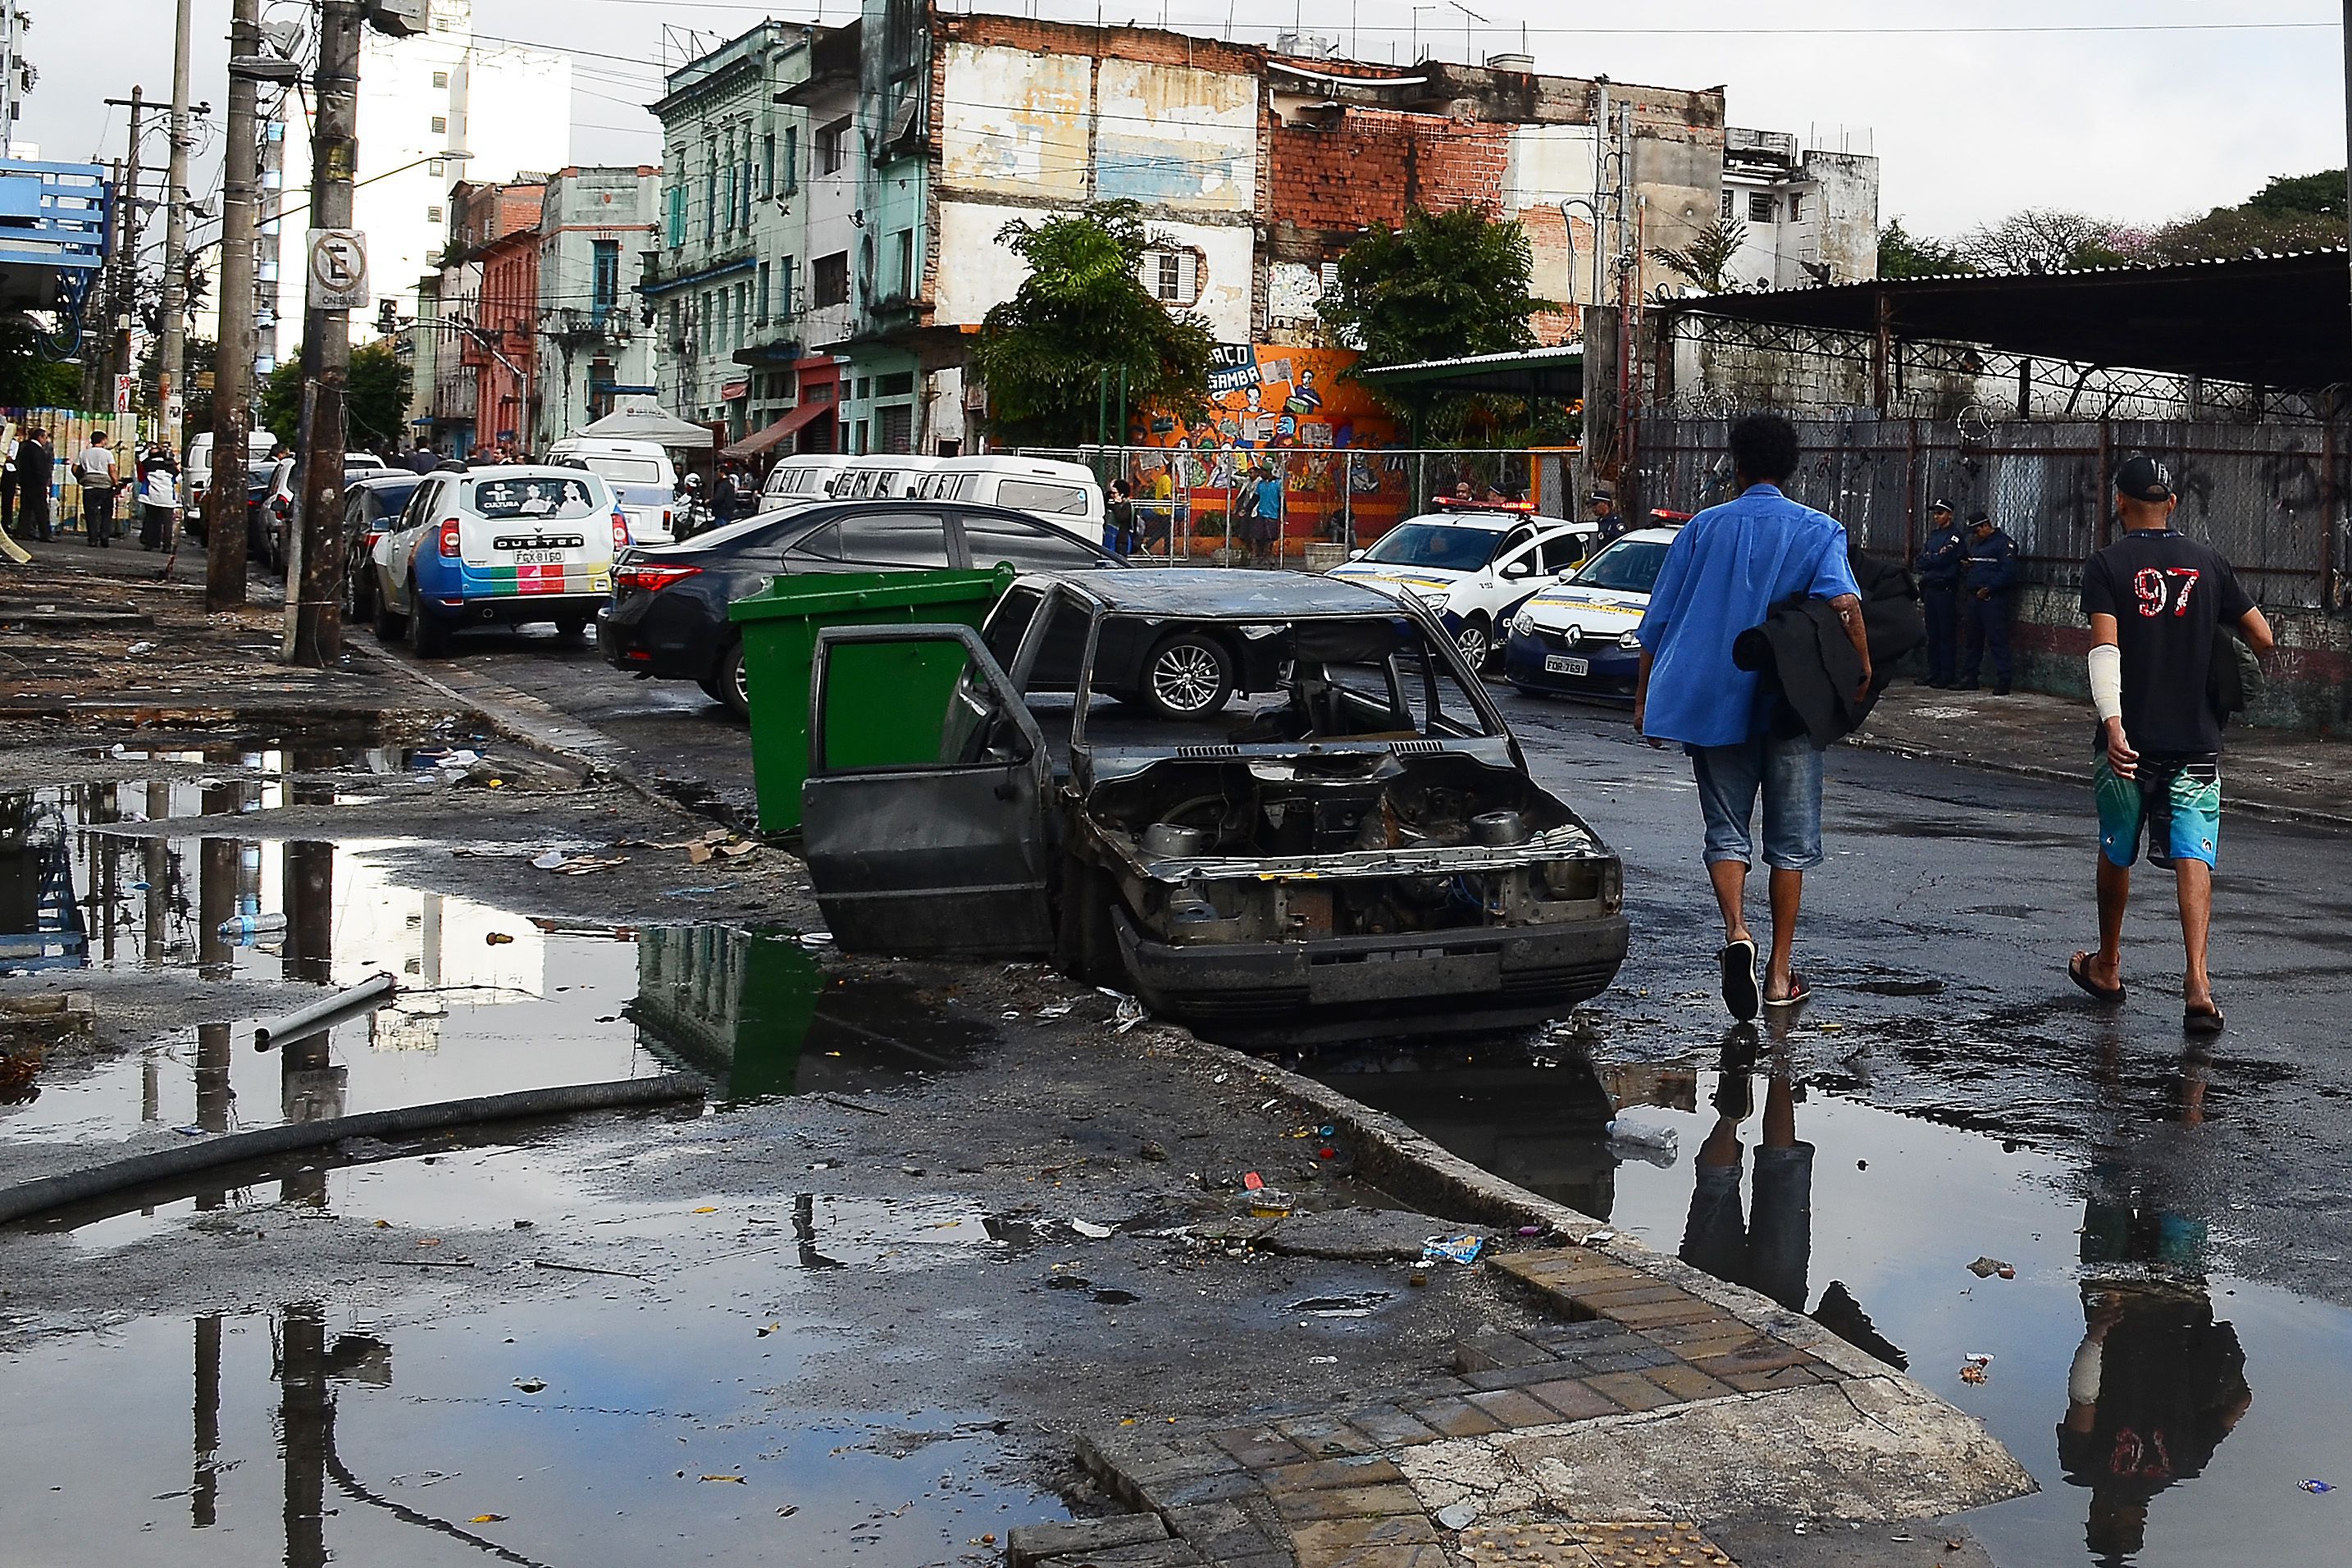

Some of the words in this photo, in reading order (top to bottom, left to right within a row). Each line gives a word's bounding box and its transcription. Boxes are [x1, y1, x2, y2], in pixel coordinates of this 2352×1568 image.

[1208, 345, 1247, 366] AÇO
[1208, 366, 1260, 390] SAMBA
[497, 538, 581, 548] DUSTER
[2134, 567, 2201, 617] 97
